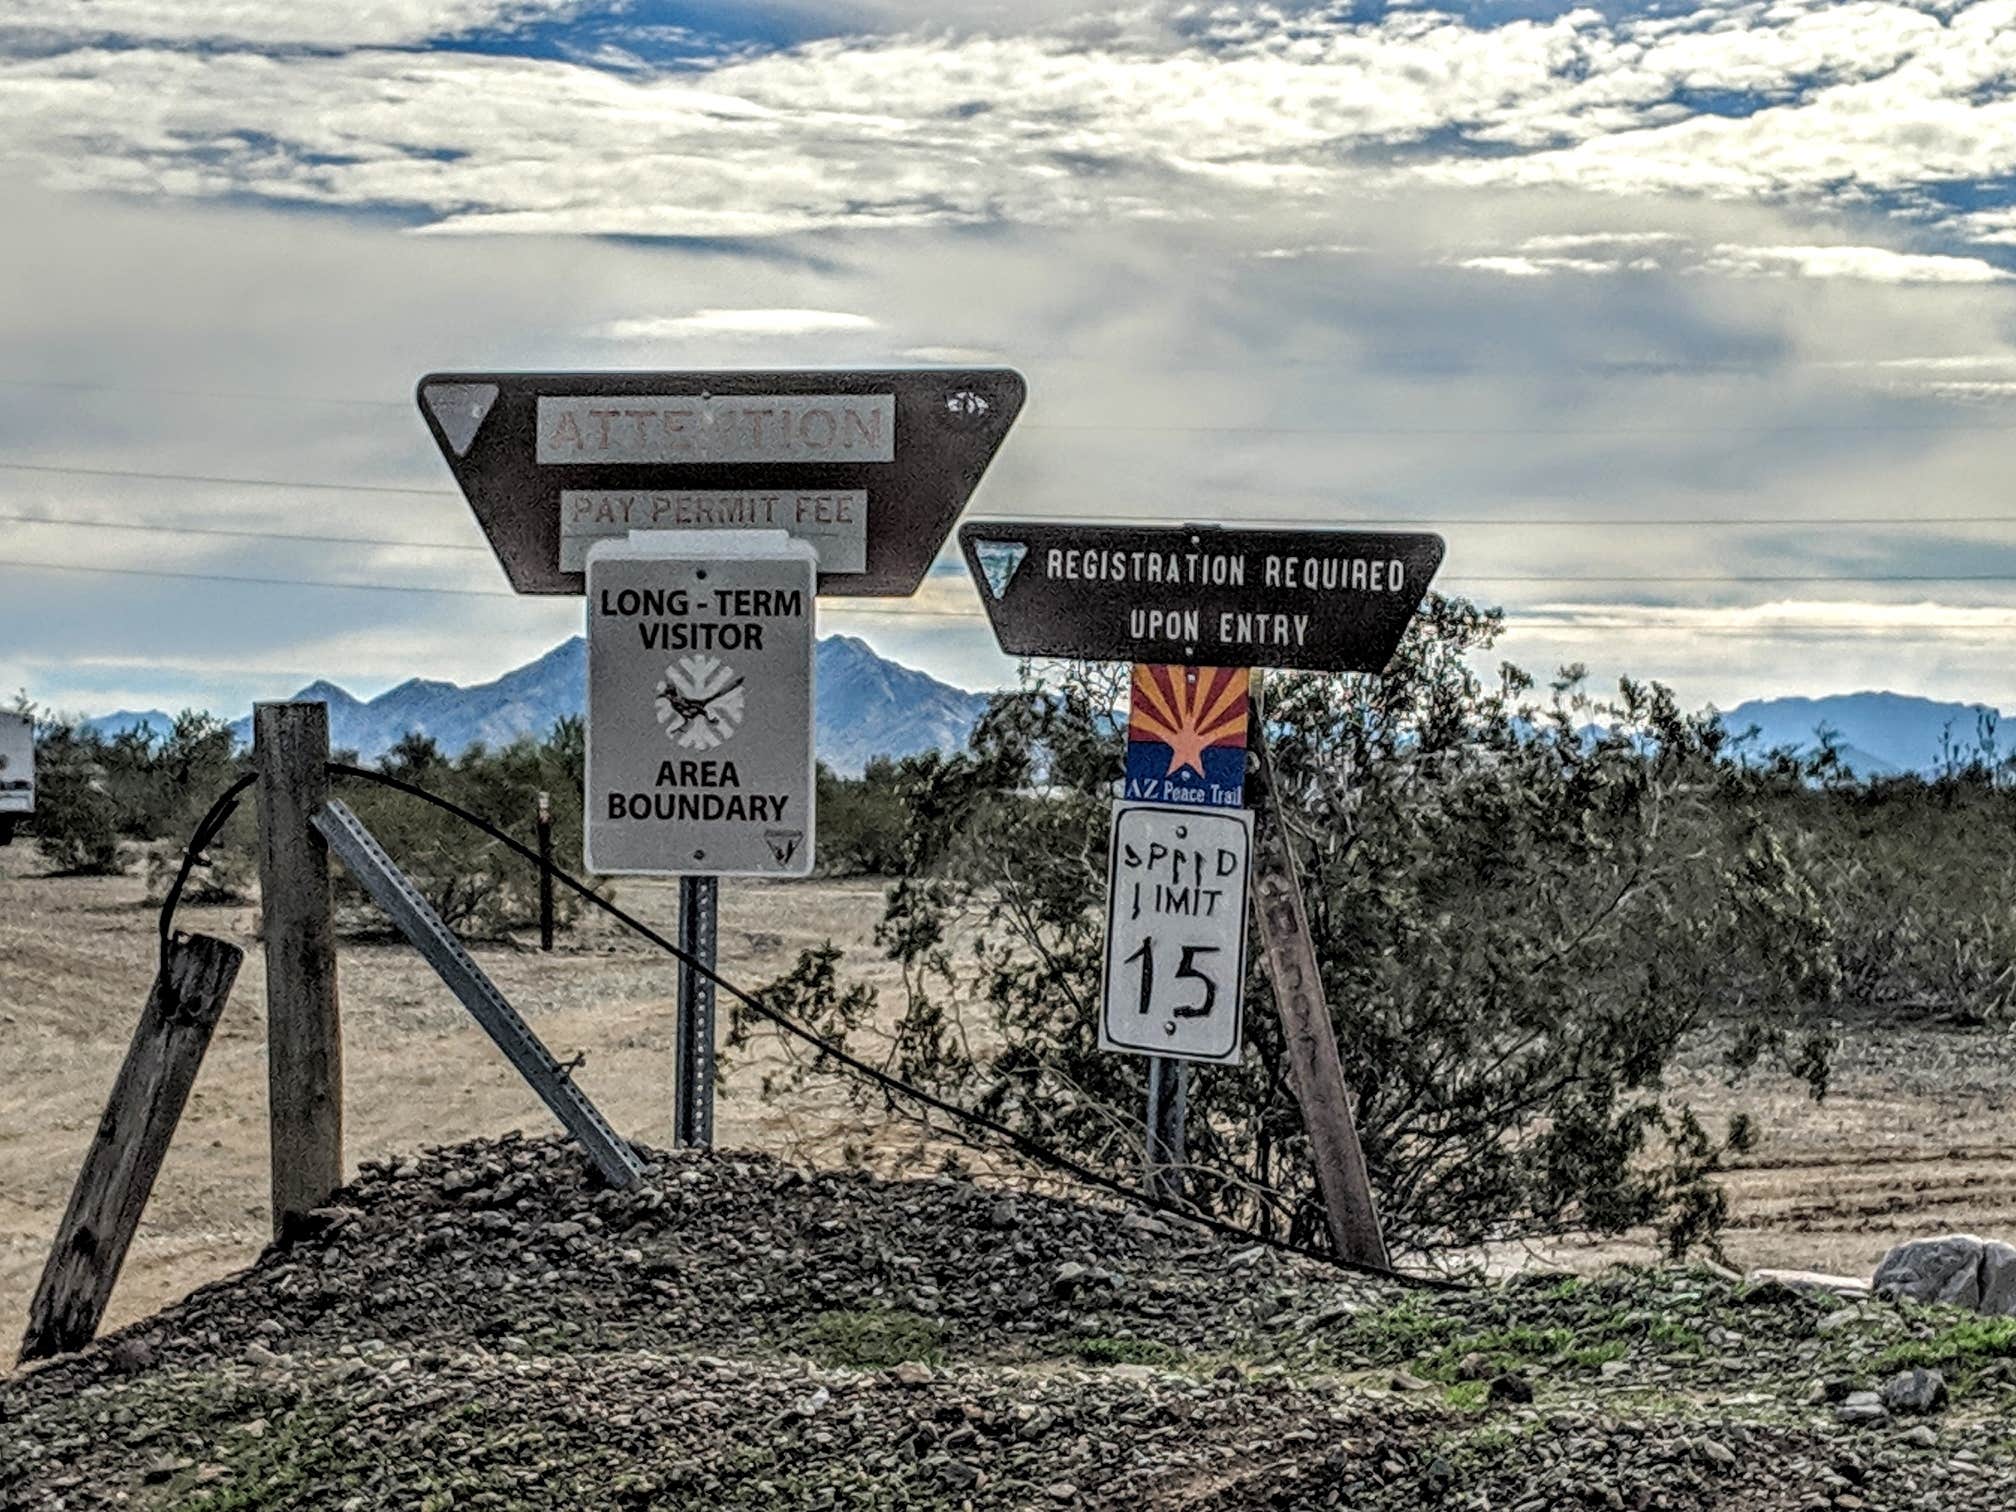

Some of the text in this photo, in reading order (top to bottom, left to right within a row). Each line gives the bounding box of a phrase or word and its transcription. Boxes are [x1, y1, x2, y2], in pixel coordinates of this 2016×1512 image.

[548, 409, 882, 451] ATTETION
[574, 497, 853, 524] PAY PERMIT FEE
[1047, 549, 1405, 592] REGISTRATION REQUIRED
[639, 623, 763, 650] VISITOR
[1130, 609, 1309, 647] UPON ENTRY
[656, 761, 740, 787] AREA
[1127, 778, 1242, 805] AZ Peace Trail
[608, 794, 788, 821] BOUNDARY
[1124, 936, 1220, 1018] 15
